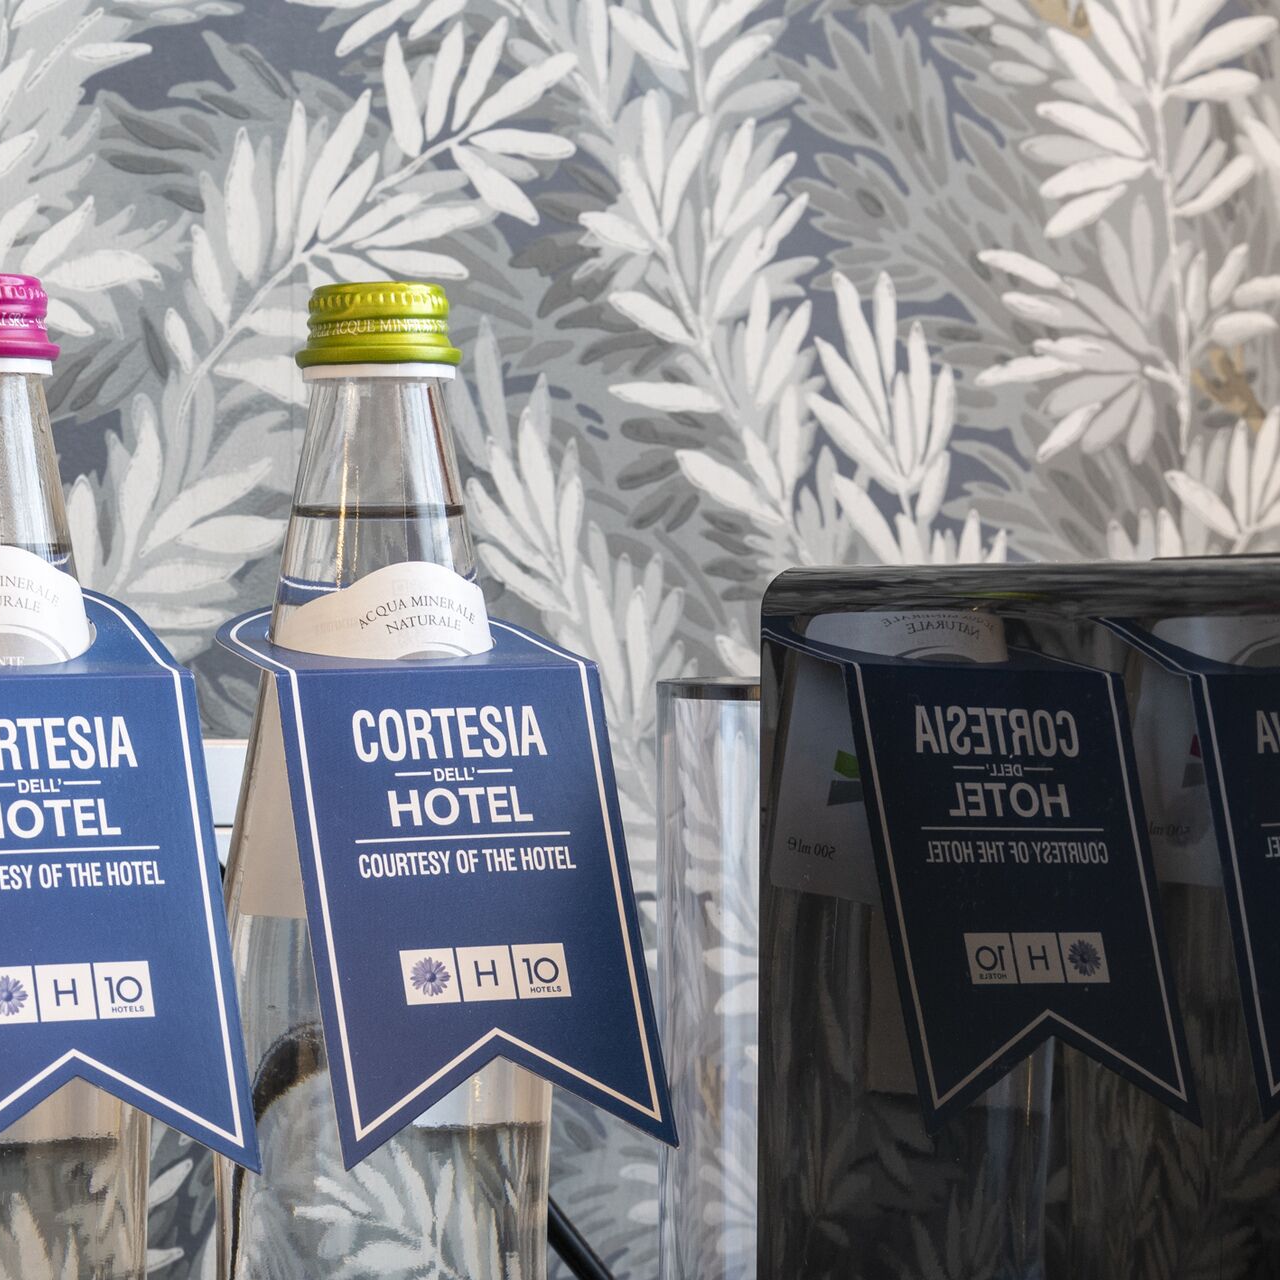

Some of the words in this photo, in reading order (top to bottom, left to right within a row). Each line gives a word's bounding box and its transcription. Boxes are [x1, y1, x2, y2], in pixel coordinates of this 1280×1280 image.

[332, 319, 376, 336] ACQUE
[358, 598, 407, 630] ACQUA
[410, 595, 477, 625] MINERALE
[385, 614, 462, 635] NATURALE
[351, 704, 548, 763] CORTESIA
[433, 765, 476, 782] DELL'
[17, 777, 62, 795] DELL'
[387, 785, 535, 828] HOTEL
[358, 850, 451, 879] COURTESY
[456, 848, 479, 874] OF
[482, 847, 518, 873] THE
[520, 845, 577, 871] HOTEL
[38, 863, 62, 890] OF
[65, 861, 106, 888] THE
[108, 860, 165, 887] HOTEL
[530, 985, 562, 993] HOTELS
[111, 1005, 145, 1014] HOTELS
